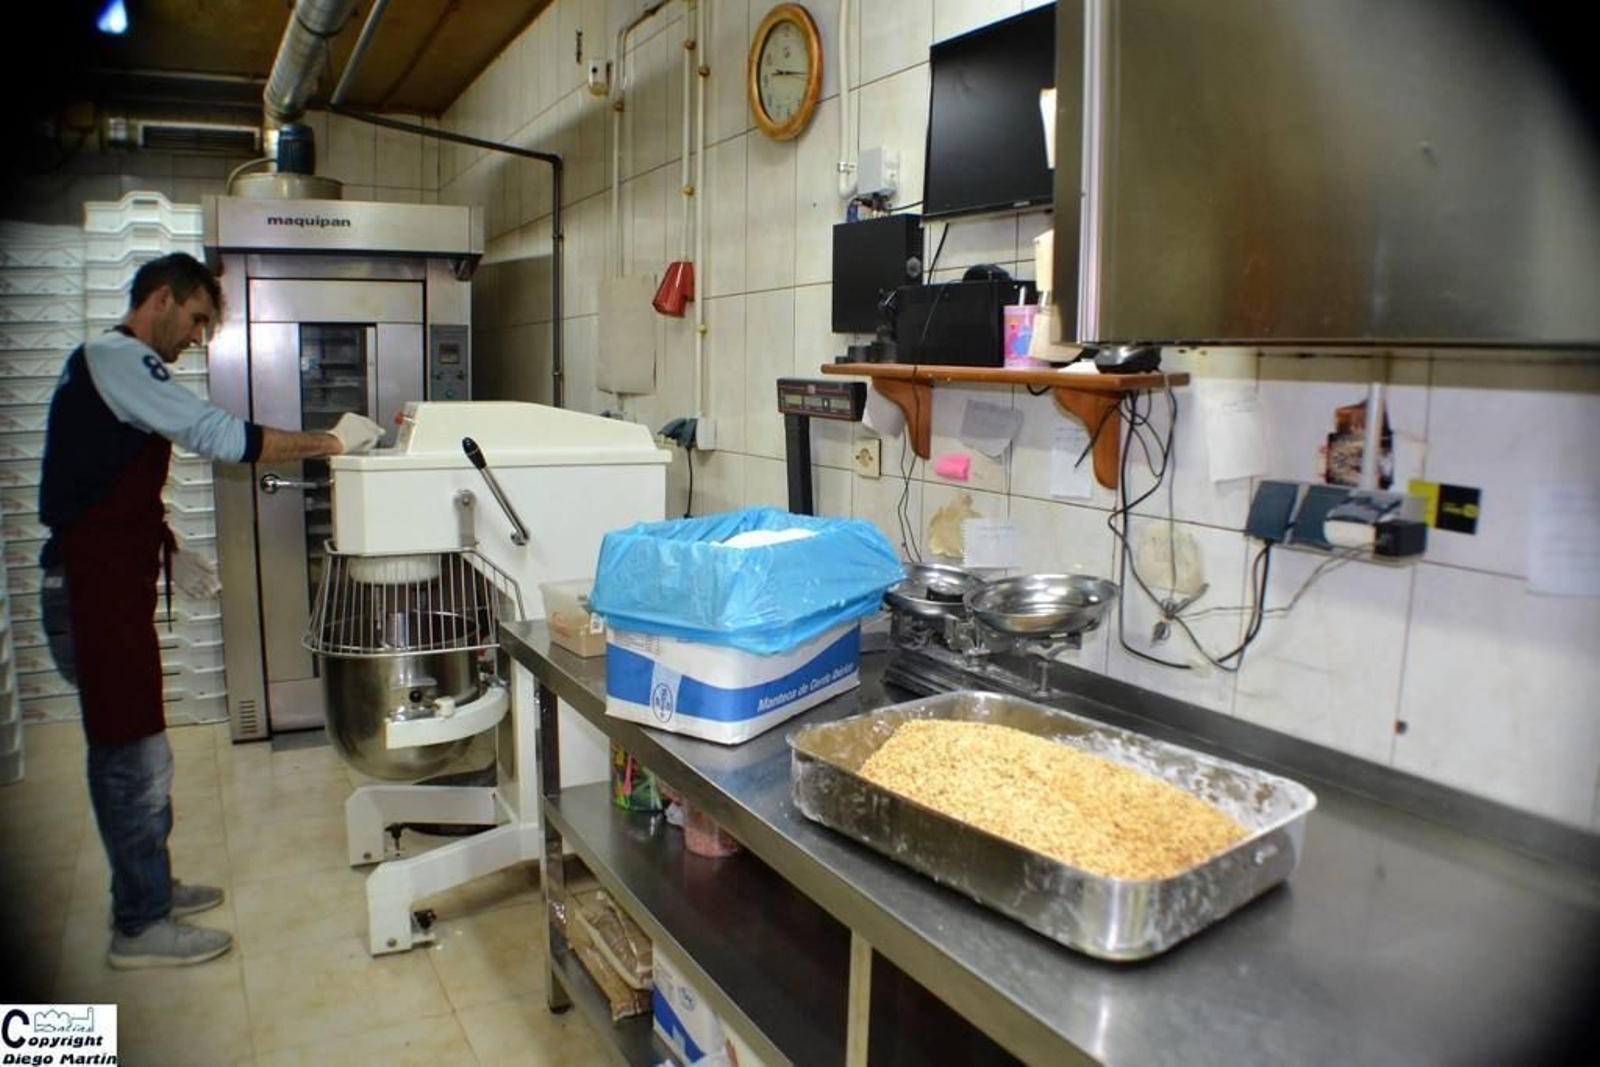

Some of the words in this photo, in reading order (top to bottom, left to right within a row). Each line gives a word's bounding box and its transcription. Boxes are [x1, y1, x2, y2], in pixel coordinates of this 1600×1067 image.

[266, 215, 352, 229] maquipan
[142, 354, 170, 382] 8
[757, 688, 797, 712] Manteca
[798, 683, 809, 696] de
